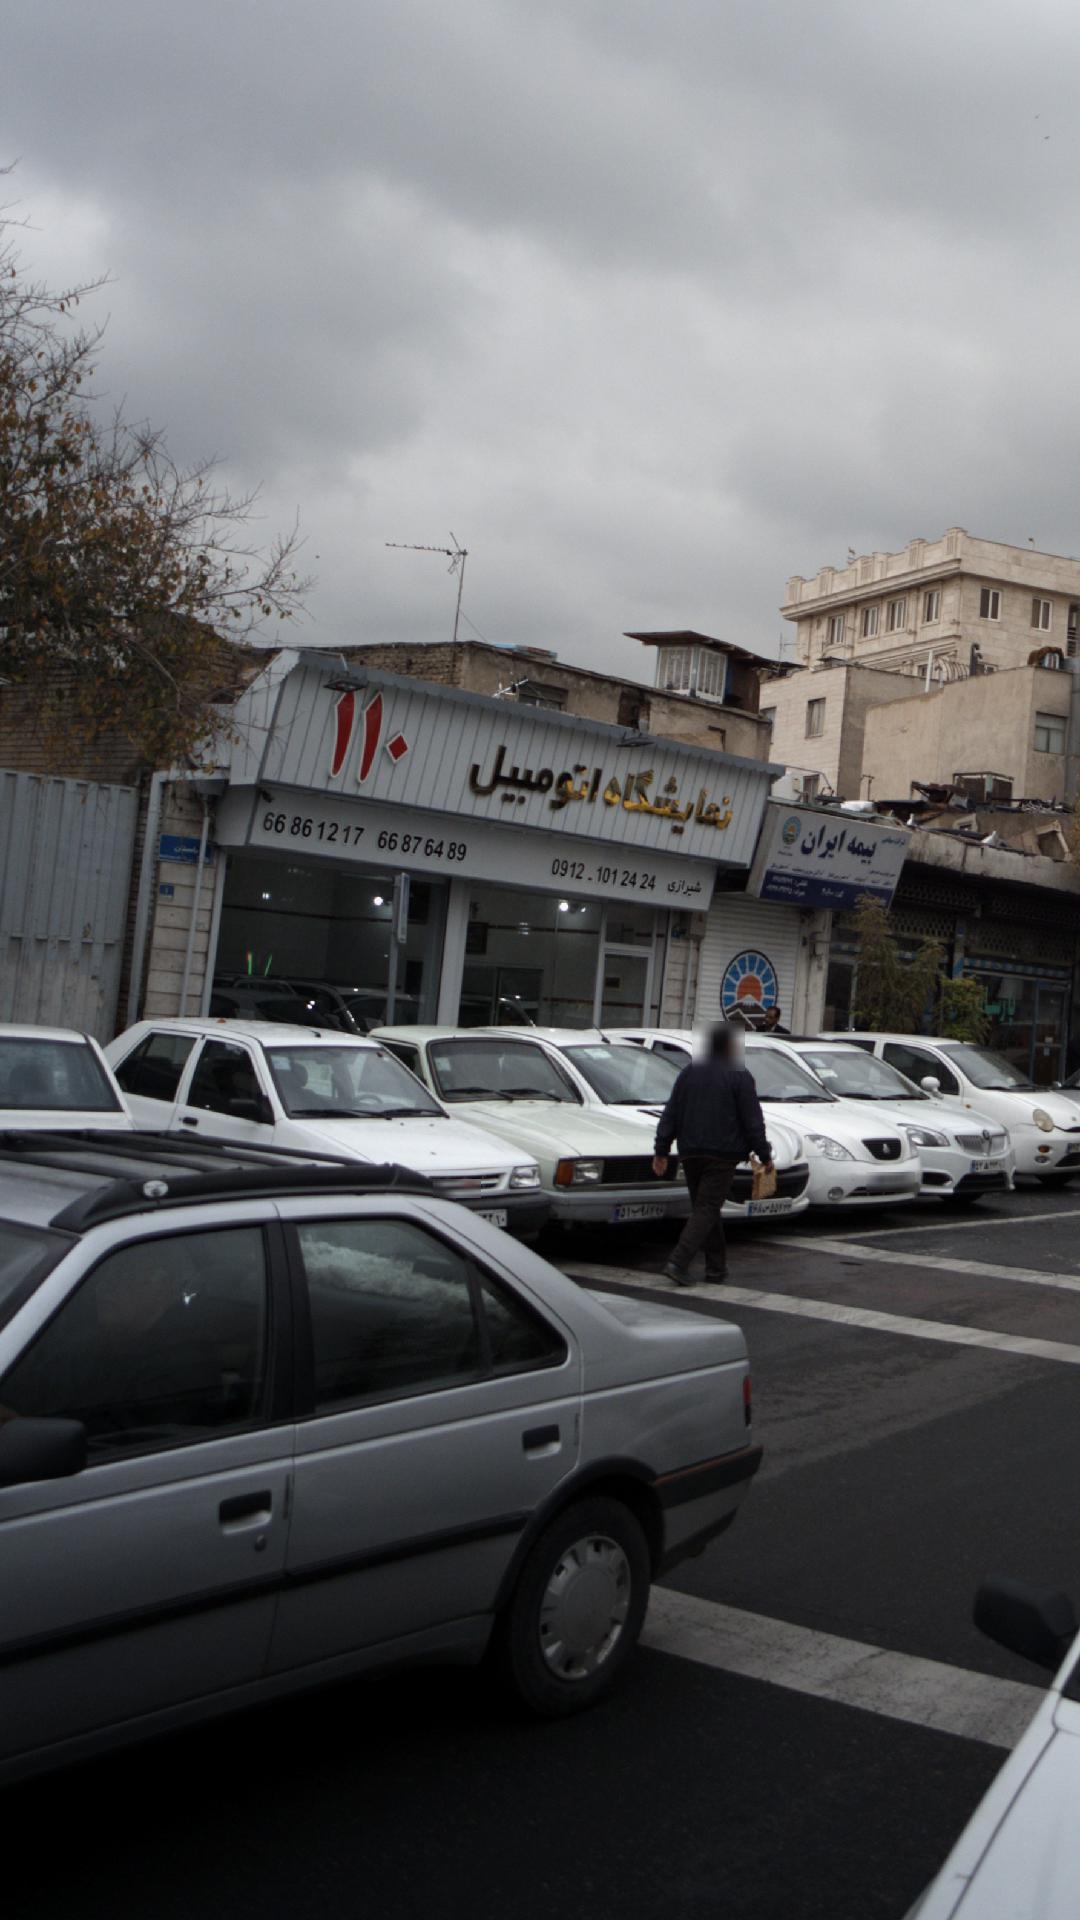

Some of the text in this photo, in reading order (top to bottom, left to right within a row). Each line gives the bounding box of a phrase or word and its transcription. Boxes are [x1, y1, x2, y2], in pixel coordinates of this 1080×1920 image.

[469, 745, 602, 810] اتومبیل
[603, 769, 733, 834] نمایشگاه
[801, 825, 877, 865] بیمه ایران
[667, 880, 702, 896] شیرازی
